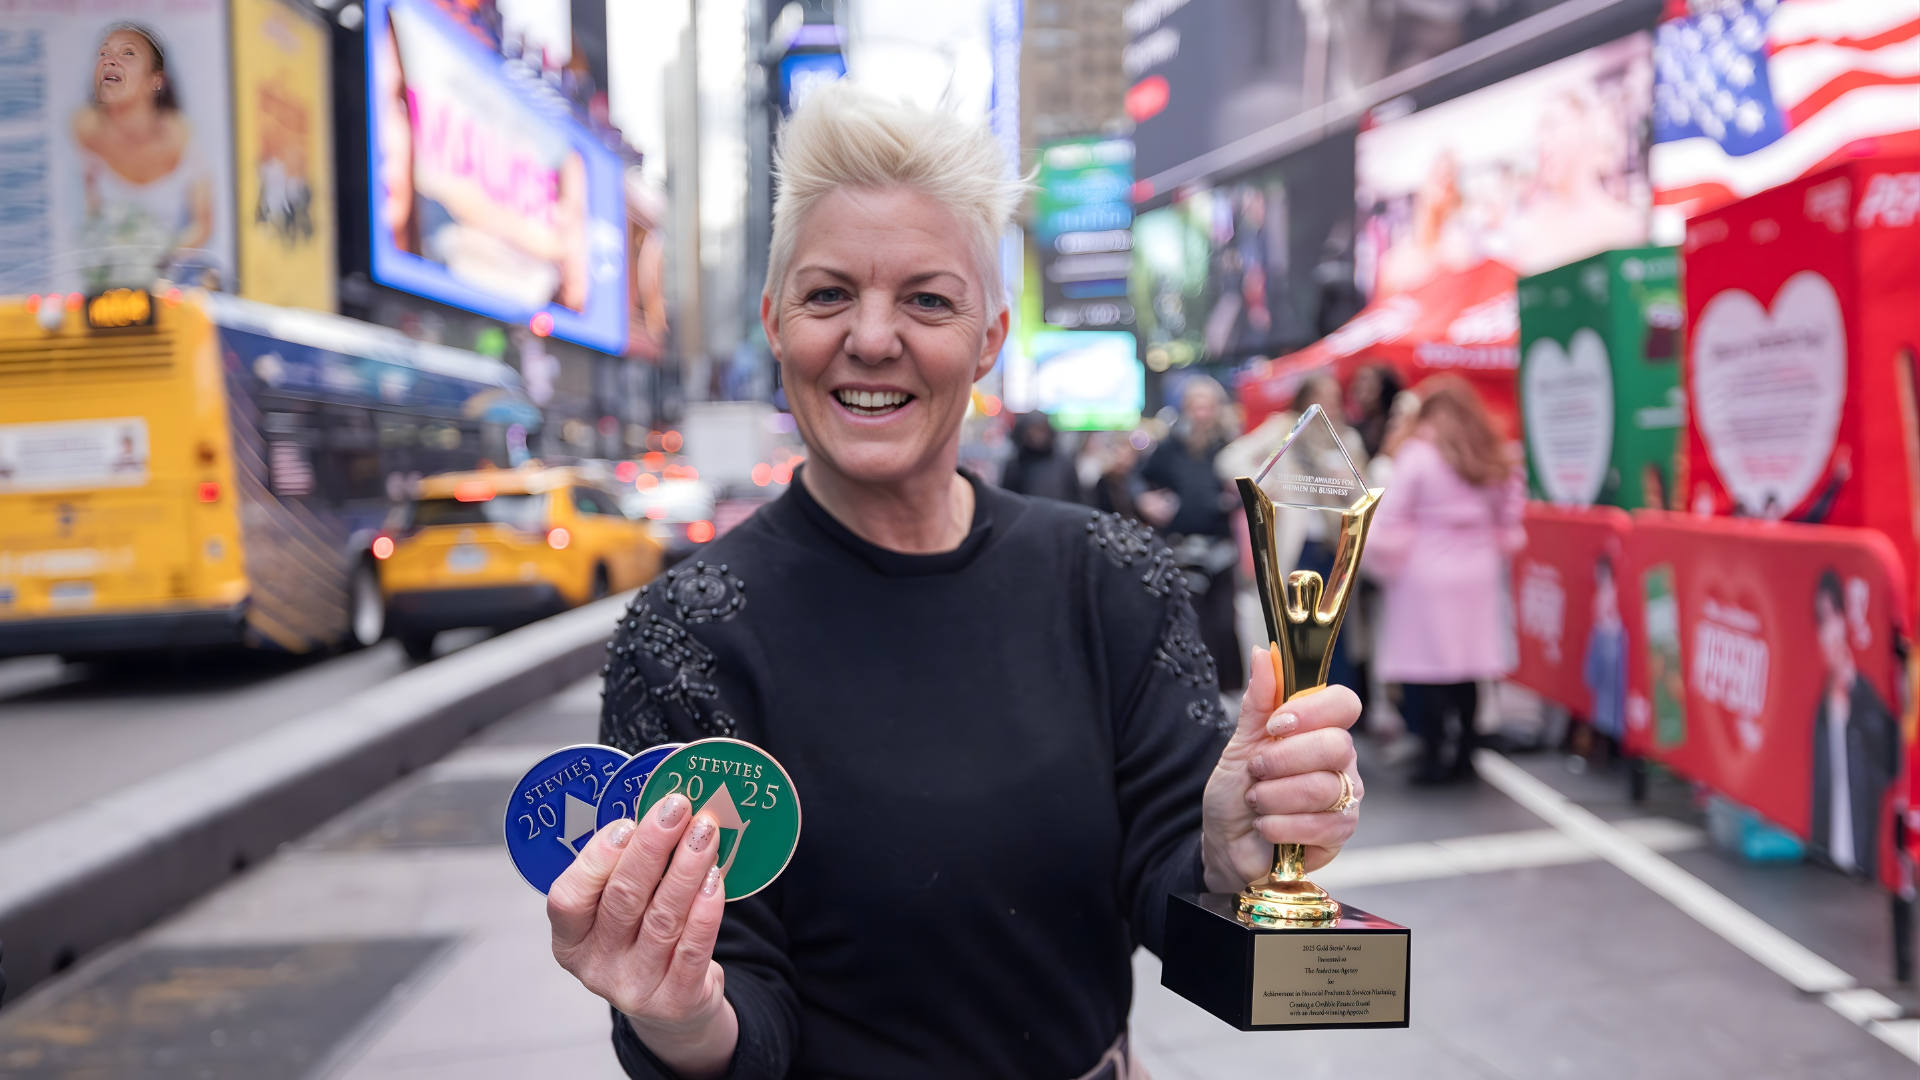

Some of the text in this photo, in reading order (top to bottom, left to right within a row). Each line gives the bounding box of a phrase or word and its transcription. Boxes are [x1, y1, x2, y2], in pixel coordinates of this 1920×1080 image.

[1314, 476, 1341, 486] AWARDS
[1341, 479, 1355, 487] FOR
[1282, 483, 1309, 493] WOMEN
[1318, 487, 1349, 496] BUSINESS
[688, 755, 763, 779] STEVIES
[523, 756, 592, 805] STEVIES
[664, 771, 780, 810] 20 25
[518, 801, 557, 840] 20
[1316, 944, 1329, 952] Gold
[1346, 944, 1362, 952] Award
[1340, 967, 1359, 976] Agency
[1371, 988, 1397, 997] Marketing
[1289, 1001, 1311, 1009] Creating
[1315, 1000, 1336, 1008] Credible
[1289, 1009, 1301, 1017] with
[1346, 1009, 1370, 1017] Approach
